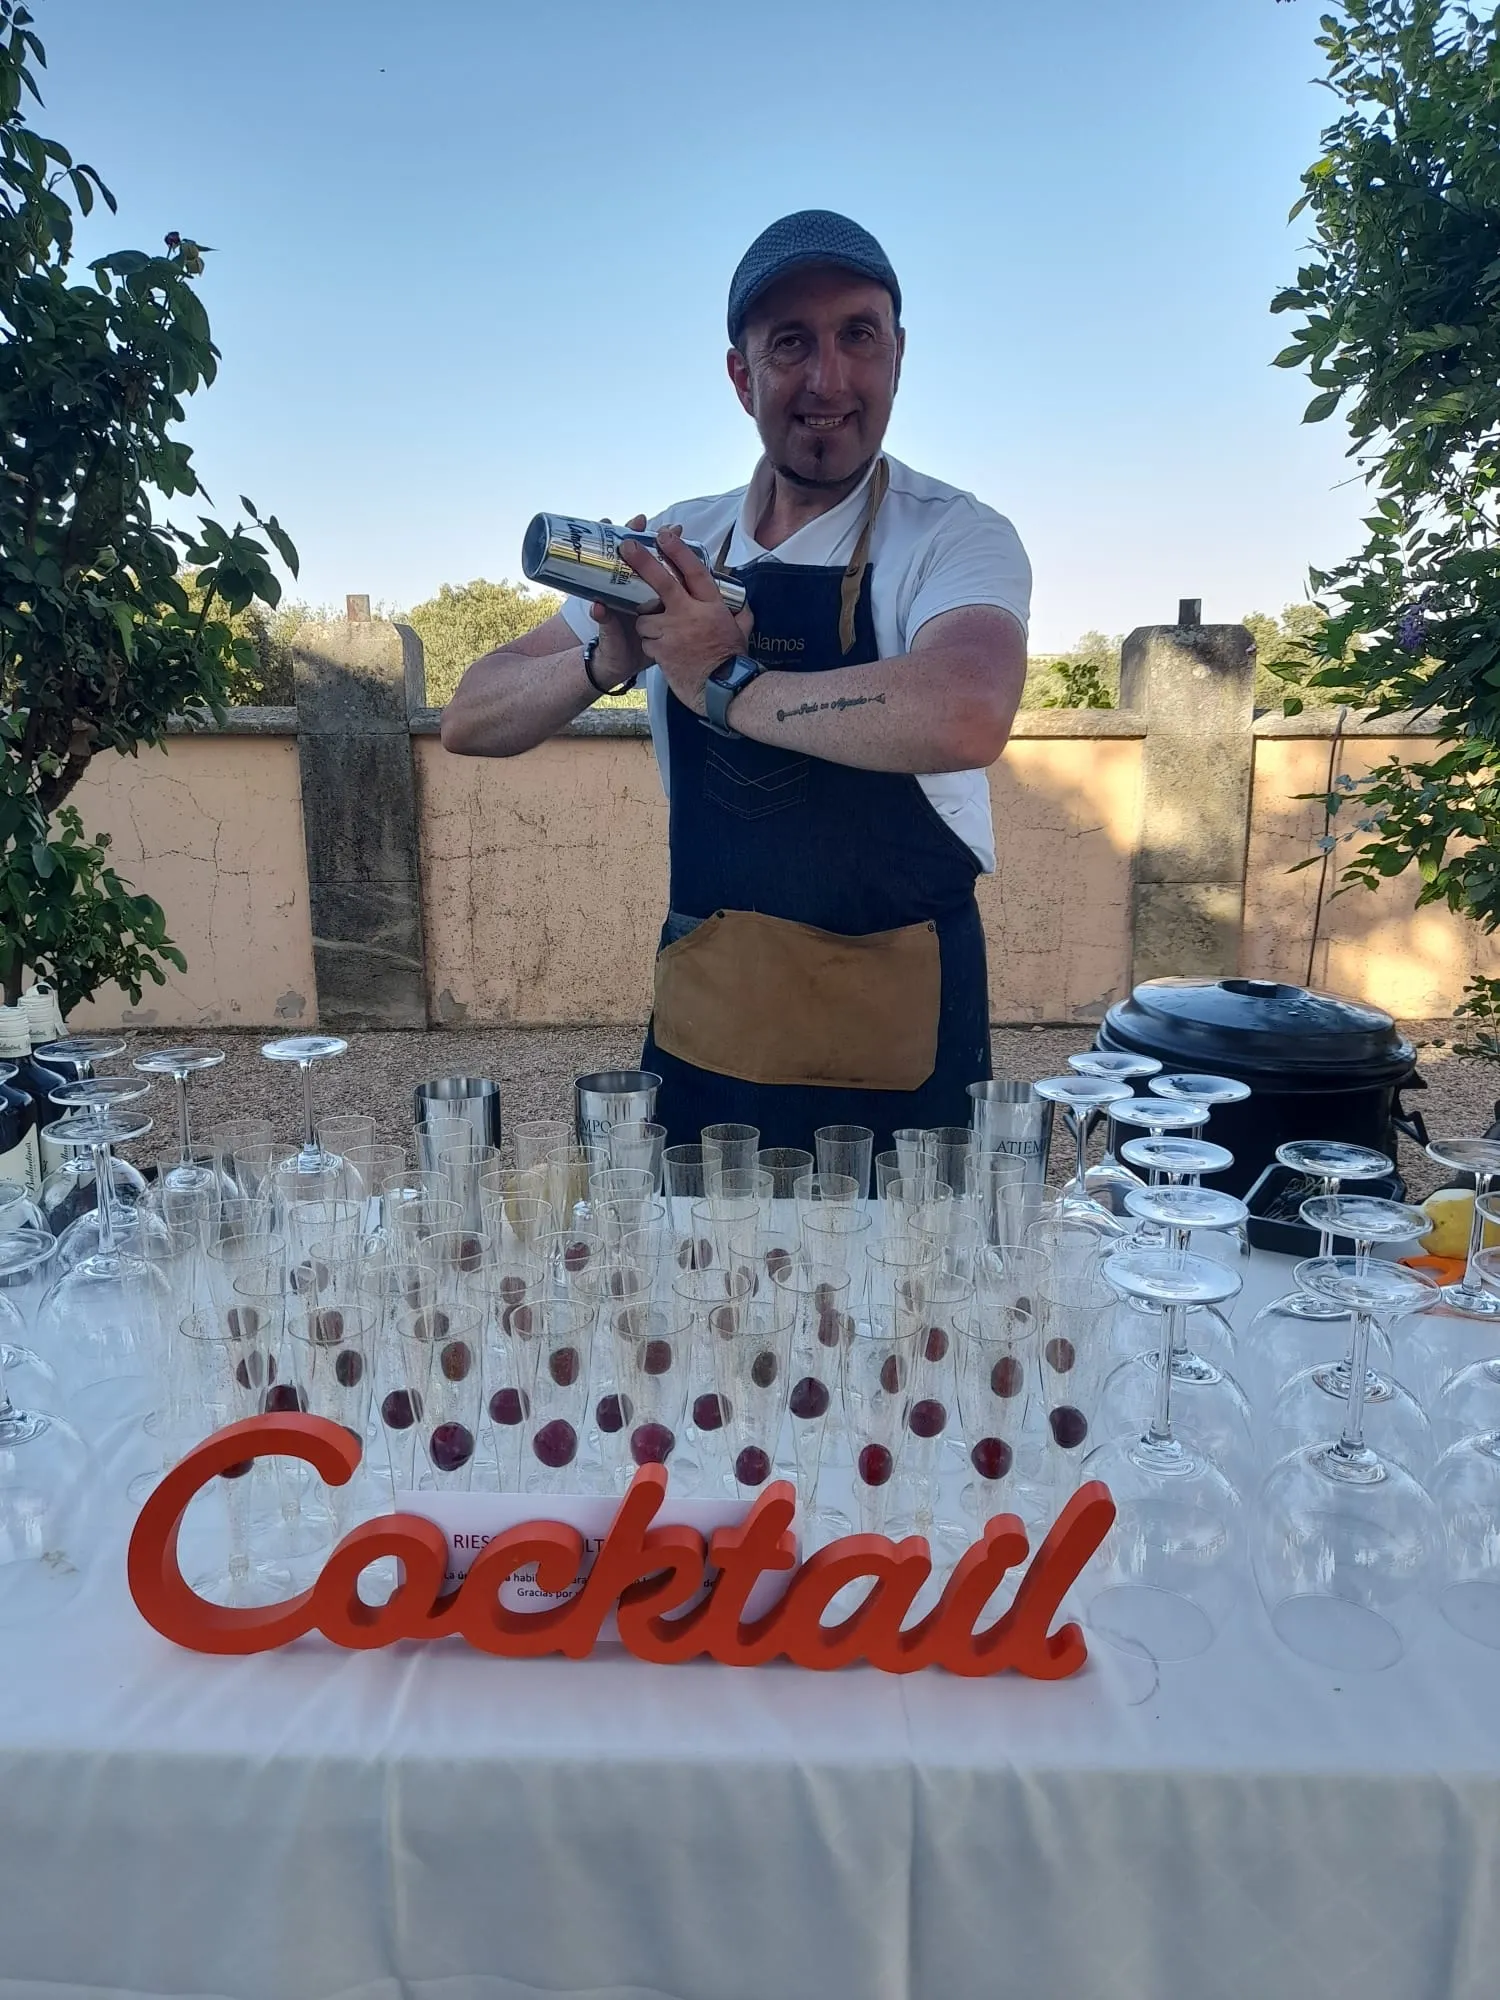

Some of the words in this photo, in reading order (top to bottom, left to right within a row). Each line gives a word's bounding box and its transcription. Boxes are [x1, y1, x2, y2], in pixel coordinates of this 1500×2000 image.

[996, 1140, 1044, 1154] ATIEM
[127, 1411, 1116, 1680] Cocktail
[453, 1534, 495, 1549] RIES
